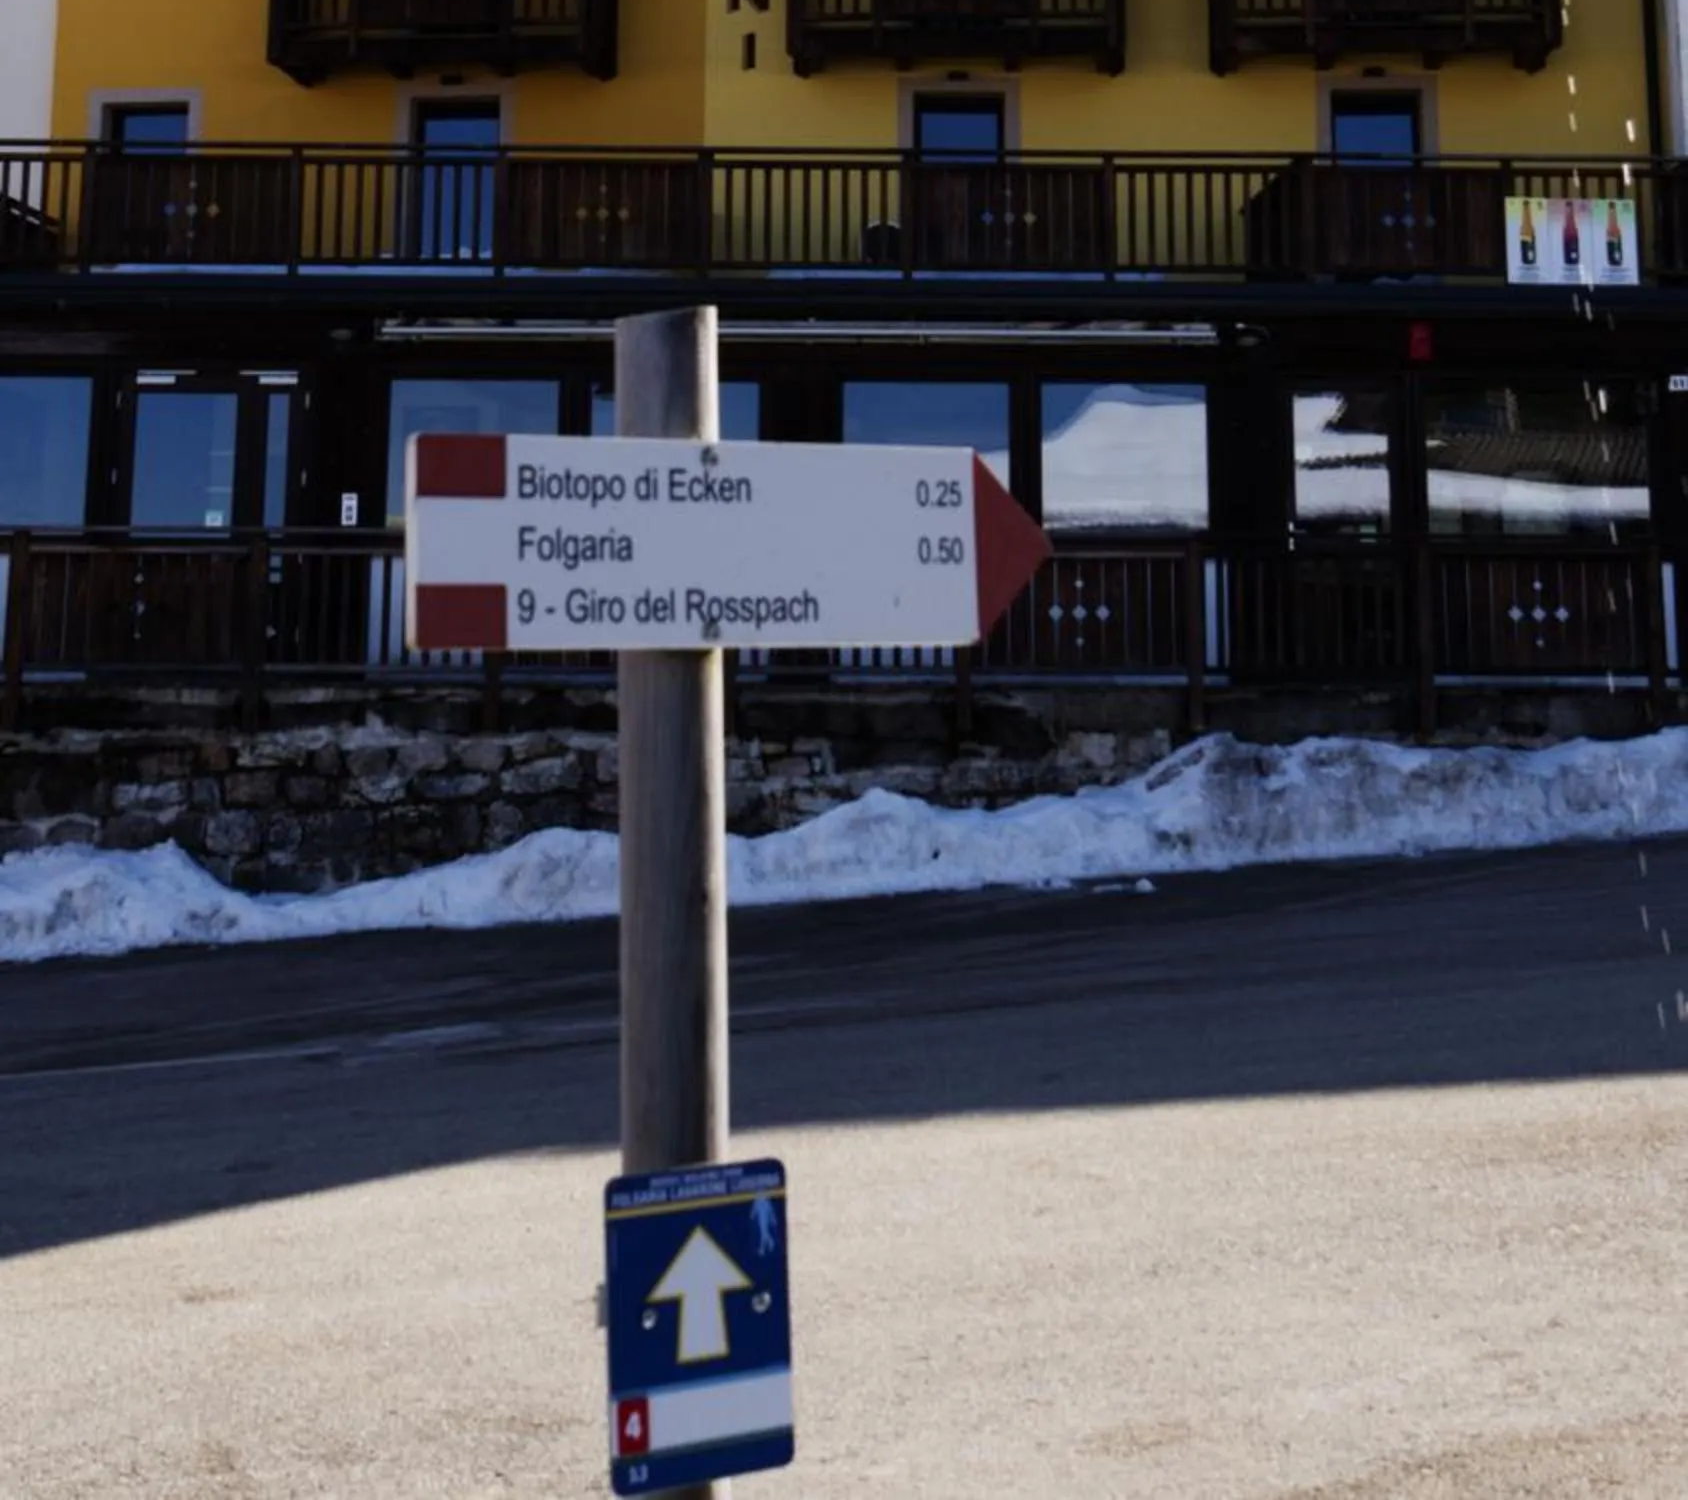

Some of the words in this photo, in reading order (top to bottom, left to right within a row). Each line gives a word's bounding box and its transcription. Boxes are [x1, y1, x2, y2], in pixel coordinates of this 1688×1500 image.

[516, 463, 626, 508] Biotopo
[634, 467, 659, 501] di
[668, 467, 752, 502] Ecken
[915, 479, 963, 508] 0.25
[517, 525, 634, 570] Folgaria
[917, 536, 964, 565] 0.50
[516, 588, 537, 624] 9
[564, 587, 626, 624] Giro
[633, 588, 676, 624] del
[684, 588, 820, 630] Rosspach
[624, 1411, 642, 1440] 4
